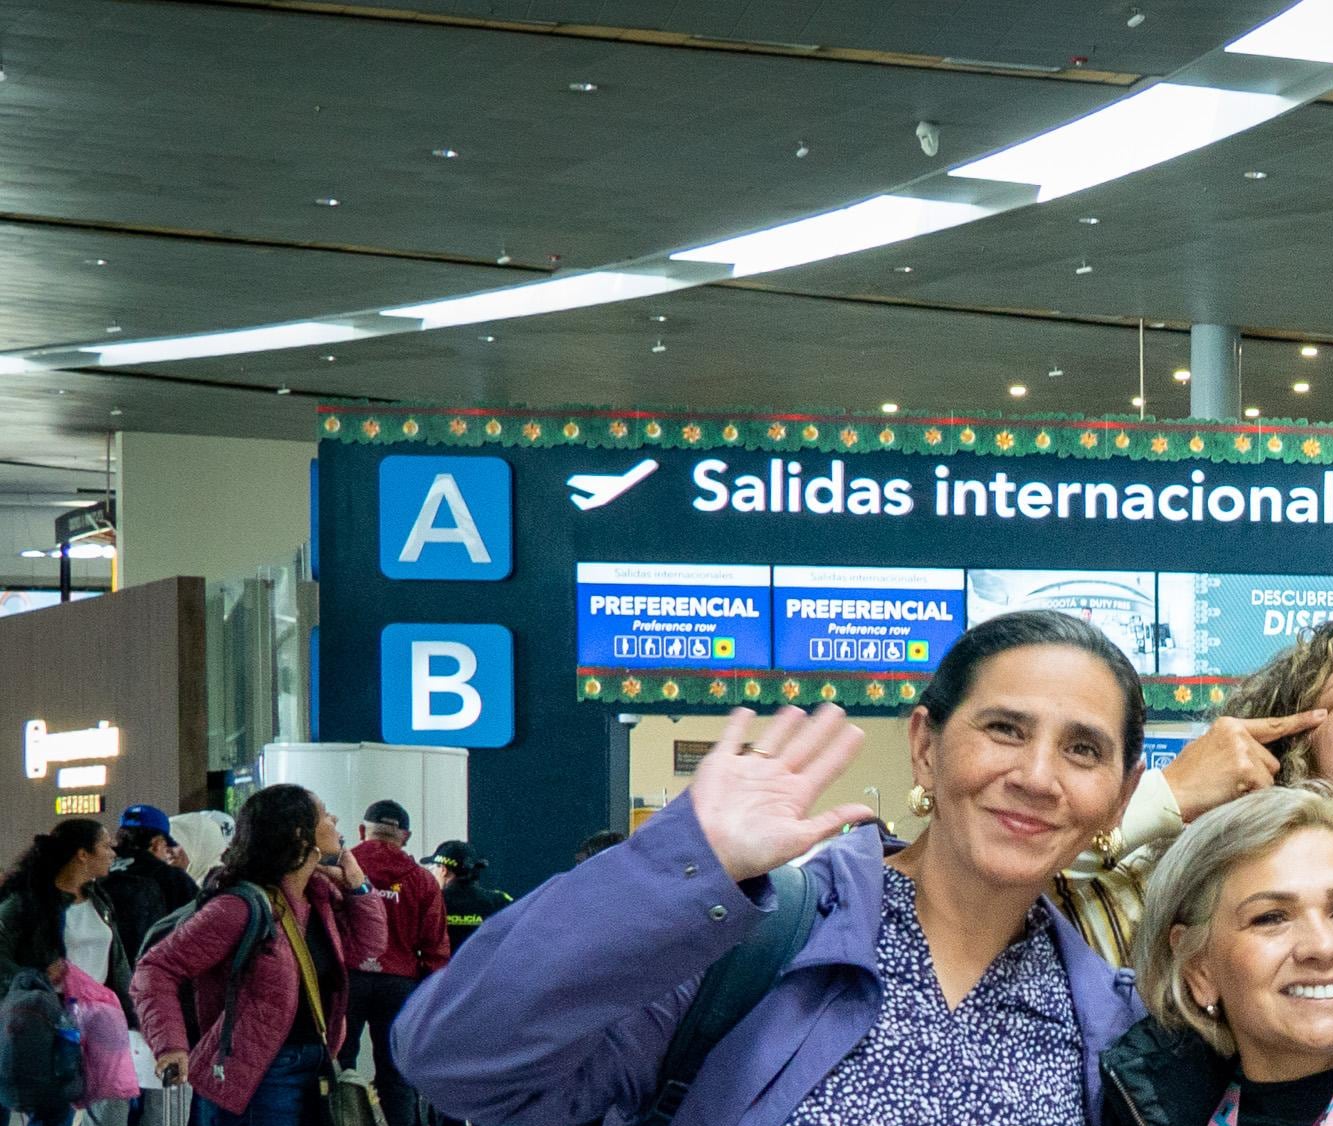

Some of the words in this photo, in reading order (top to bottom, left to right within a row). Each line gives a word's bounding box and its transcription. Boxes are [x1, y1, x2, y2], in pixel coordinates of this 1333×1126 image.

[692, 458, 914, 517] Salidas
[398, 473, 492, 563] A
[590, 595, 760, 618] PREFERENCIAL
[786, 599, 953, 621] PREFERENCIAL
[1045, 598, 1078, 609] OGOTÁ
[632, 620, 693, 633] Preference
[695, 622, 717, 633] row
[828, 622, 887, 635] Preference
[889, 625, 911, 636] row
[411, 641, 482, 731] B
